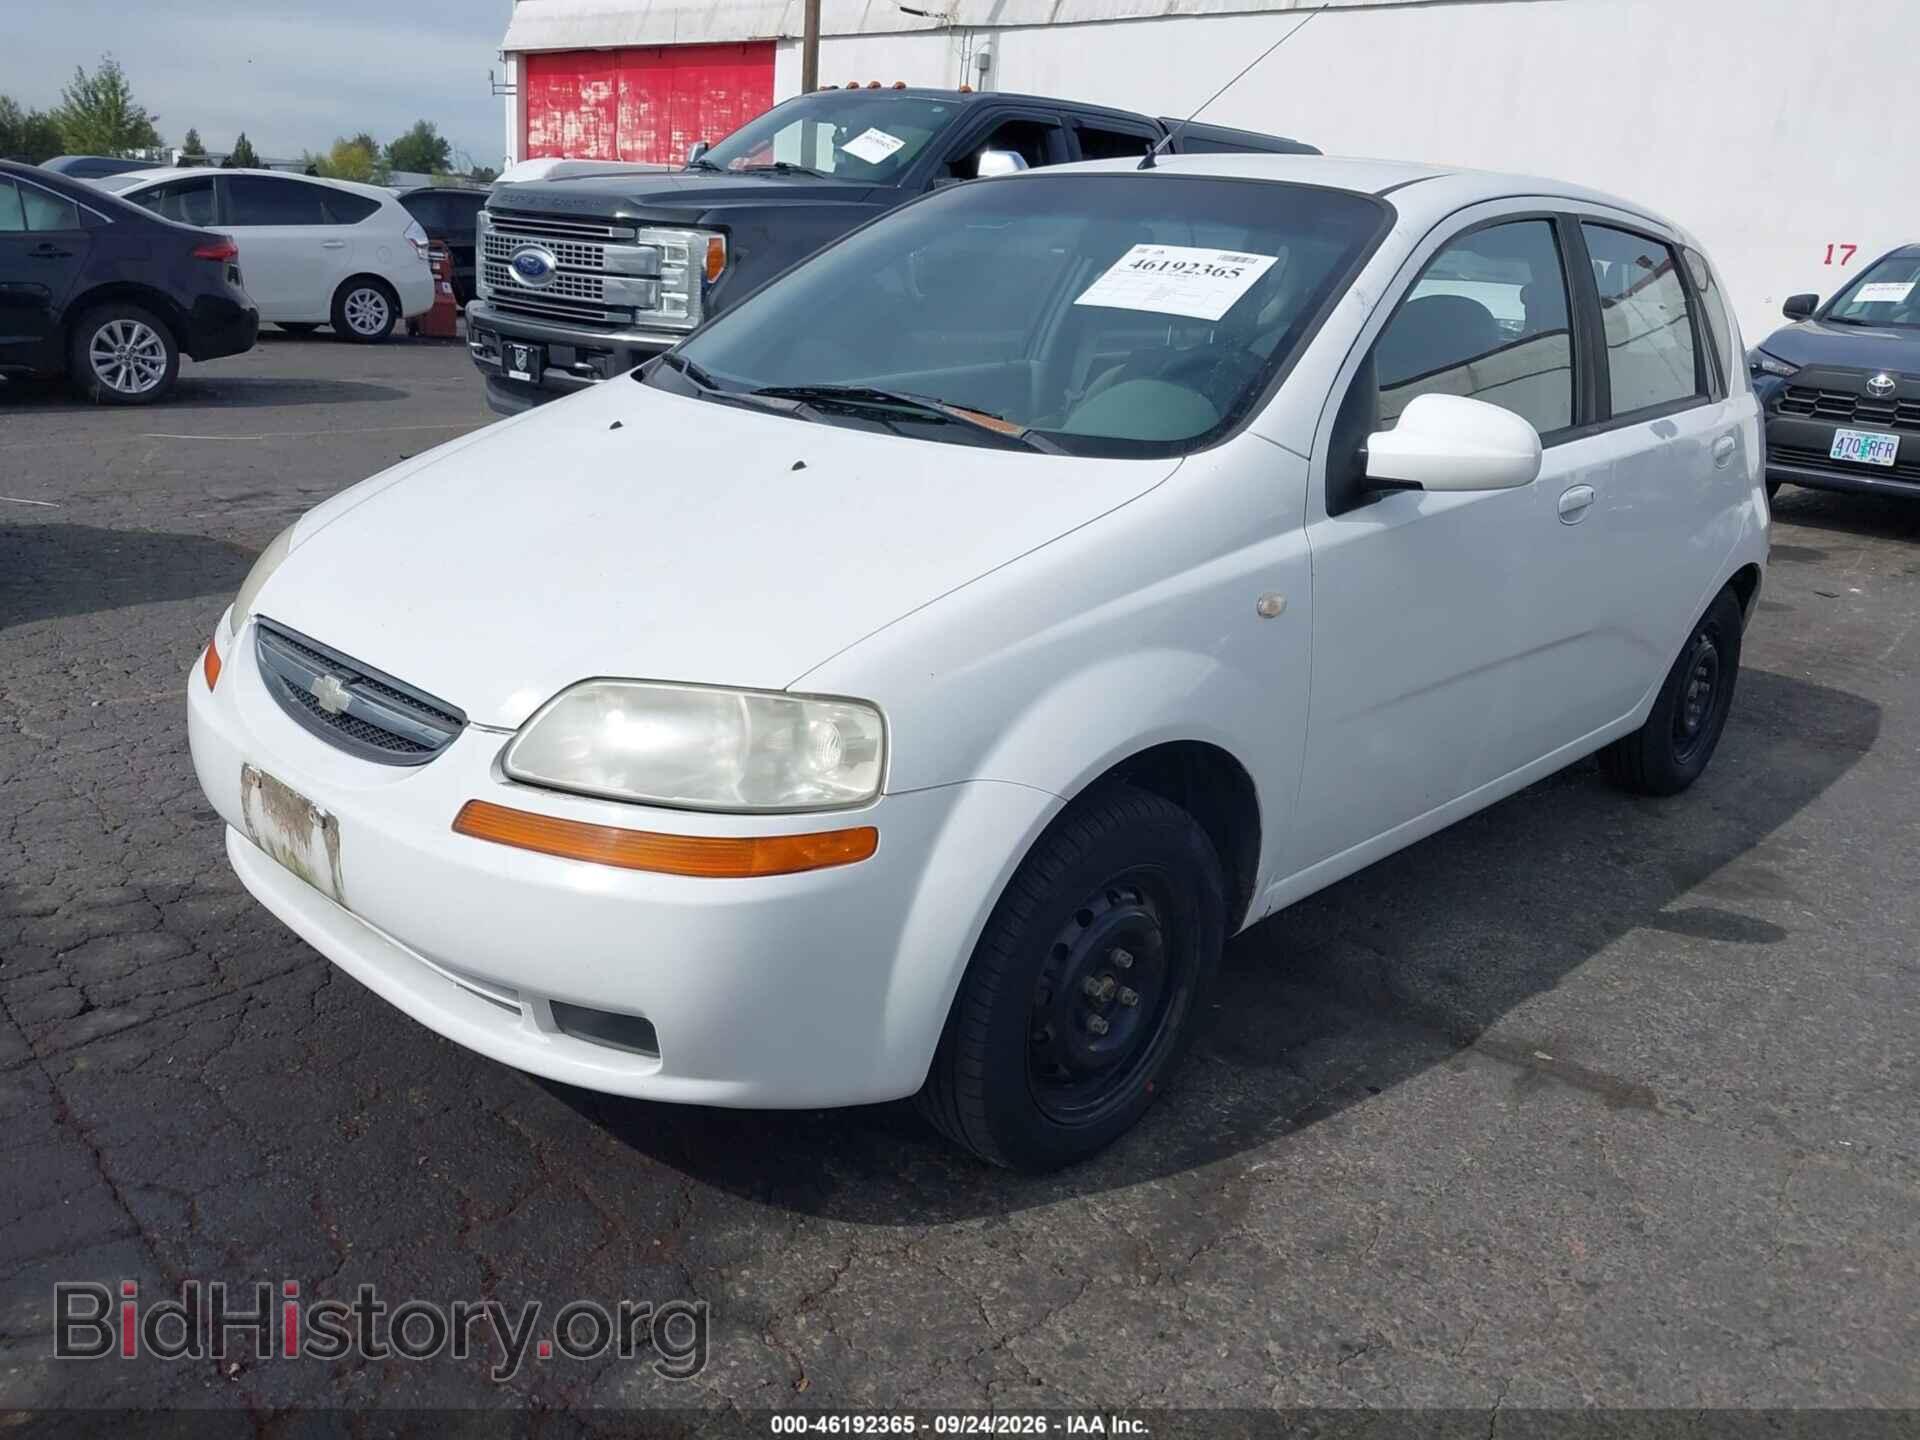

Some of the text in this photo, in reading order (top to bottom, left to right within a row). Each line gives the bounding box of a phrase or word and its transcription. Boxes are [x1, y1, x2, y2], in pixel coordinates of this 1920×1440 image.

[1824, 243, 1857, 266] 17
[1129, 259, 1245, 279] 46192365
[1836, 437, 1895, 458] 470 RFR
